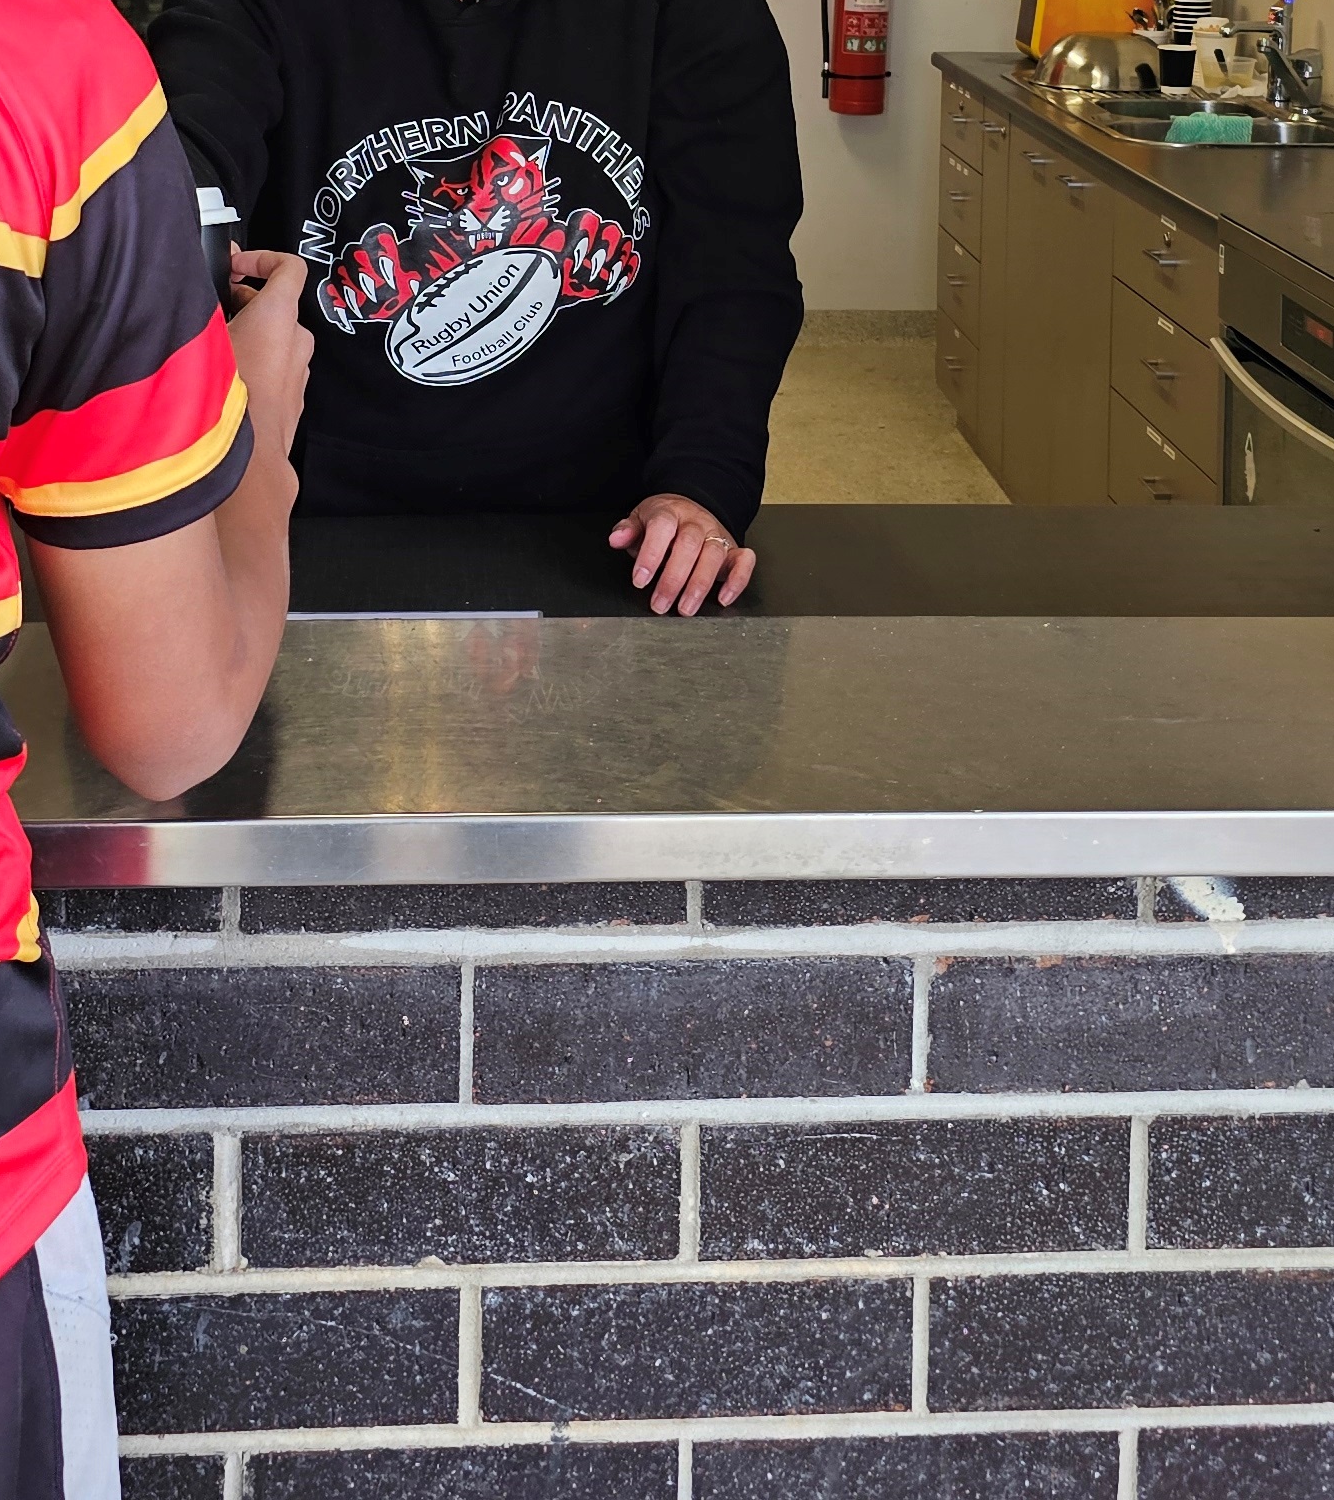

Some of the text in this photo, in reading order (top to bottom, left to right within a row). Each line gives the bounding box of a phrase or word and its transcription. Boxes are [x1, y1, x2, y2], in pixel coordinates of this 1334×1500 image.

[298, 111, 490, 264] NORTHERN
[411, 264, 520, 354] Rugby Union
[451, 301, 543, 367] Football Club
